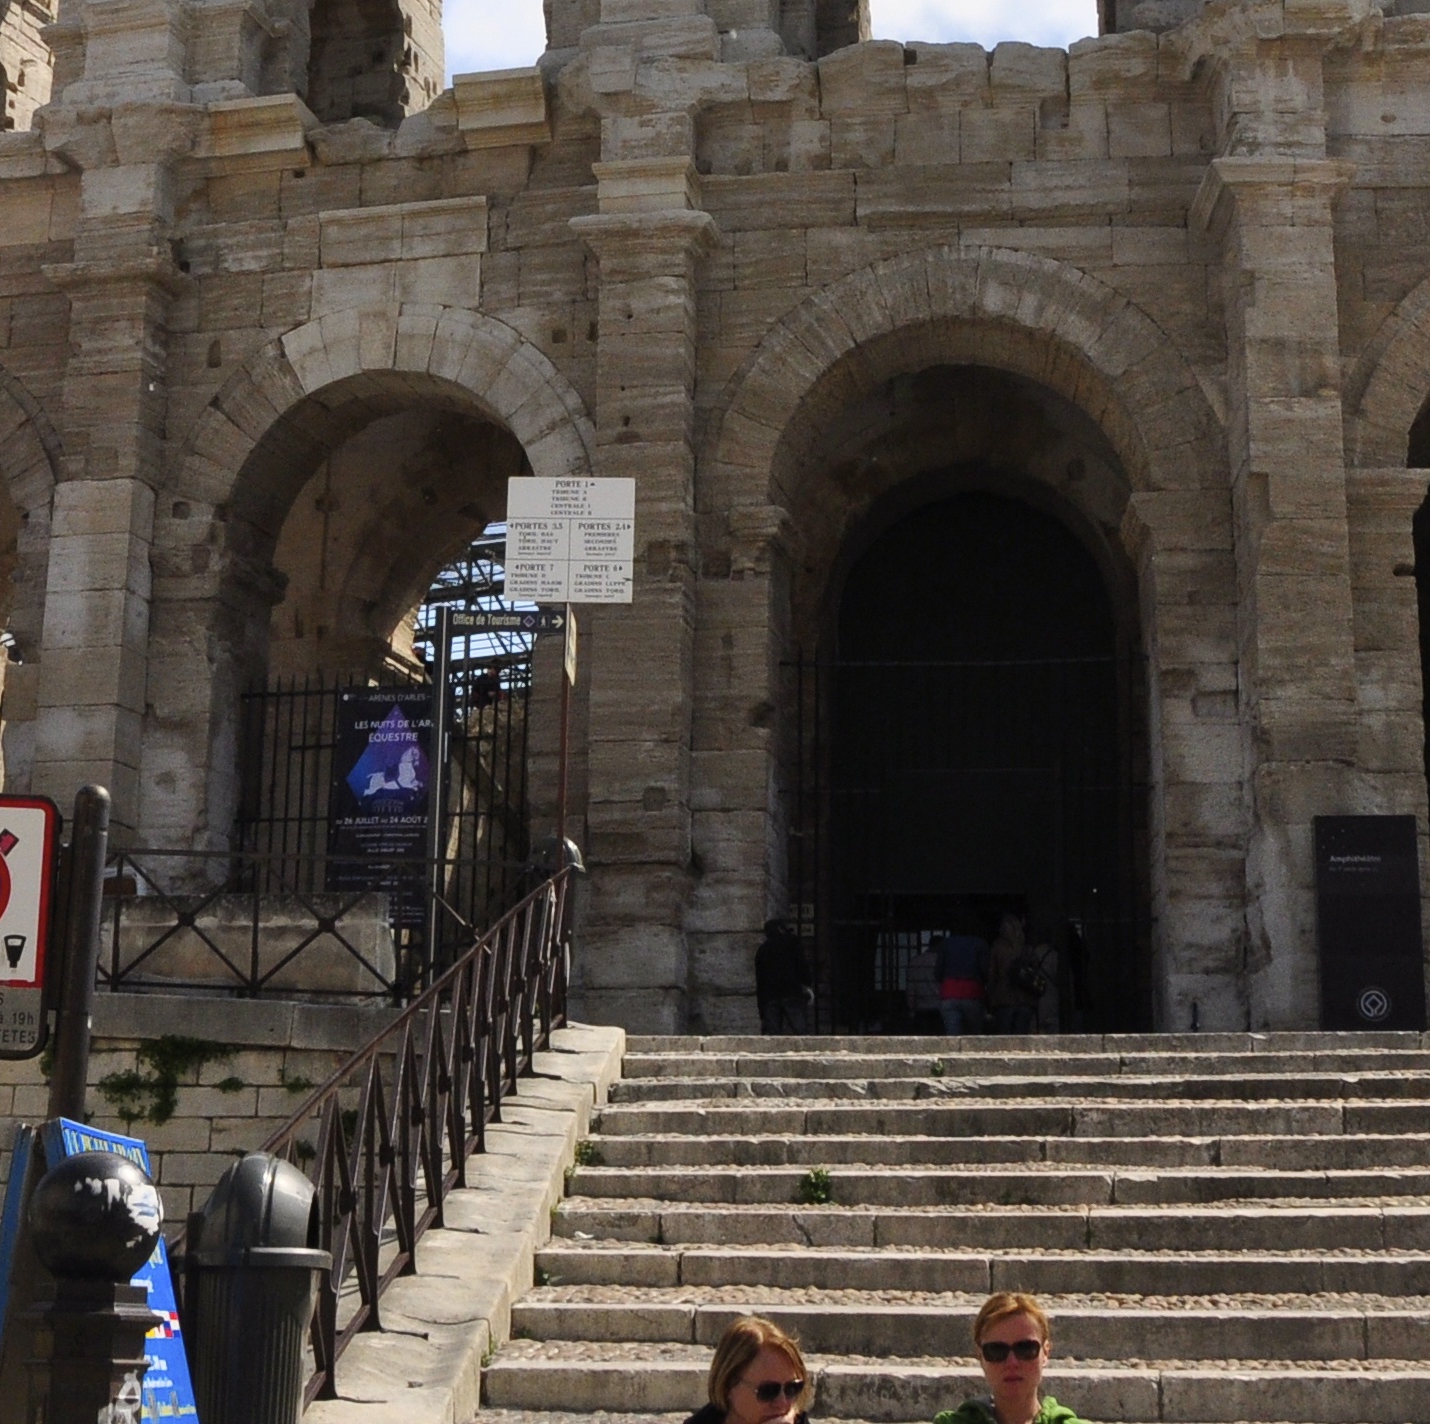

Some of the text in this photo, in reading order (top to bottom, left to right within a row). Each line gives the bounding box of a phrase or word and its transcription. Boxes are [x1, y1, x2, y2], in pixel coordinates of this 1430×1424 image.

[555, 480, 582, 488] PORTE
[515, 522, 548, 530] PORTES
[578, 522, 611, 530] PORTES
[583, 564, 610, 572] PORTE
[452, 613, 521, 626] Office de Tourisme
[397, 693, 426, 702] D'ARLES
[354, 719, 434, 729] LES NUITS DE L'AR
[368, 731, 419, 742] ÉQUESTRE
[344, 817, 352, 825] 26
[13, 1011, 34, 1025] 19h
